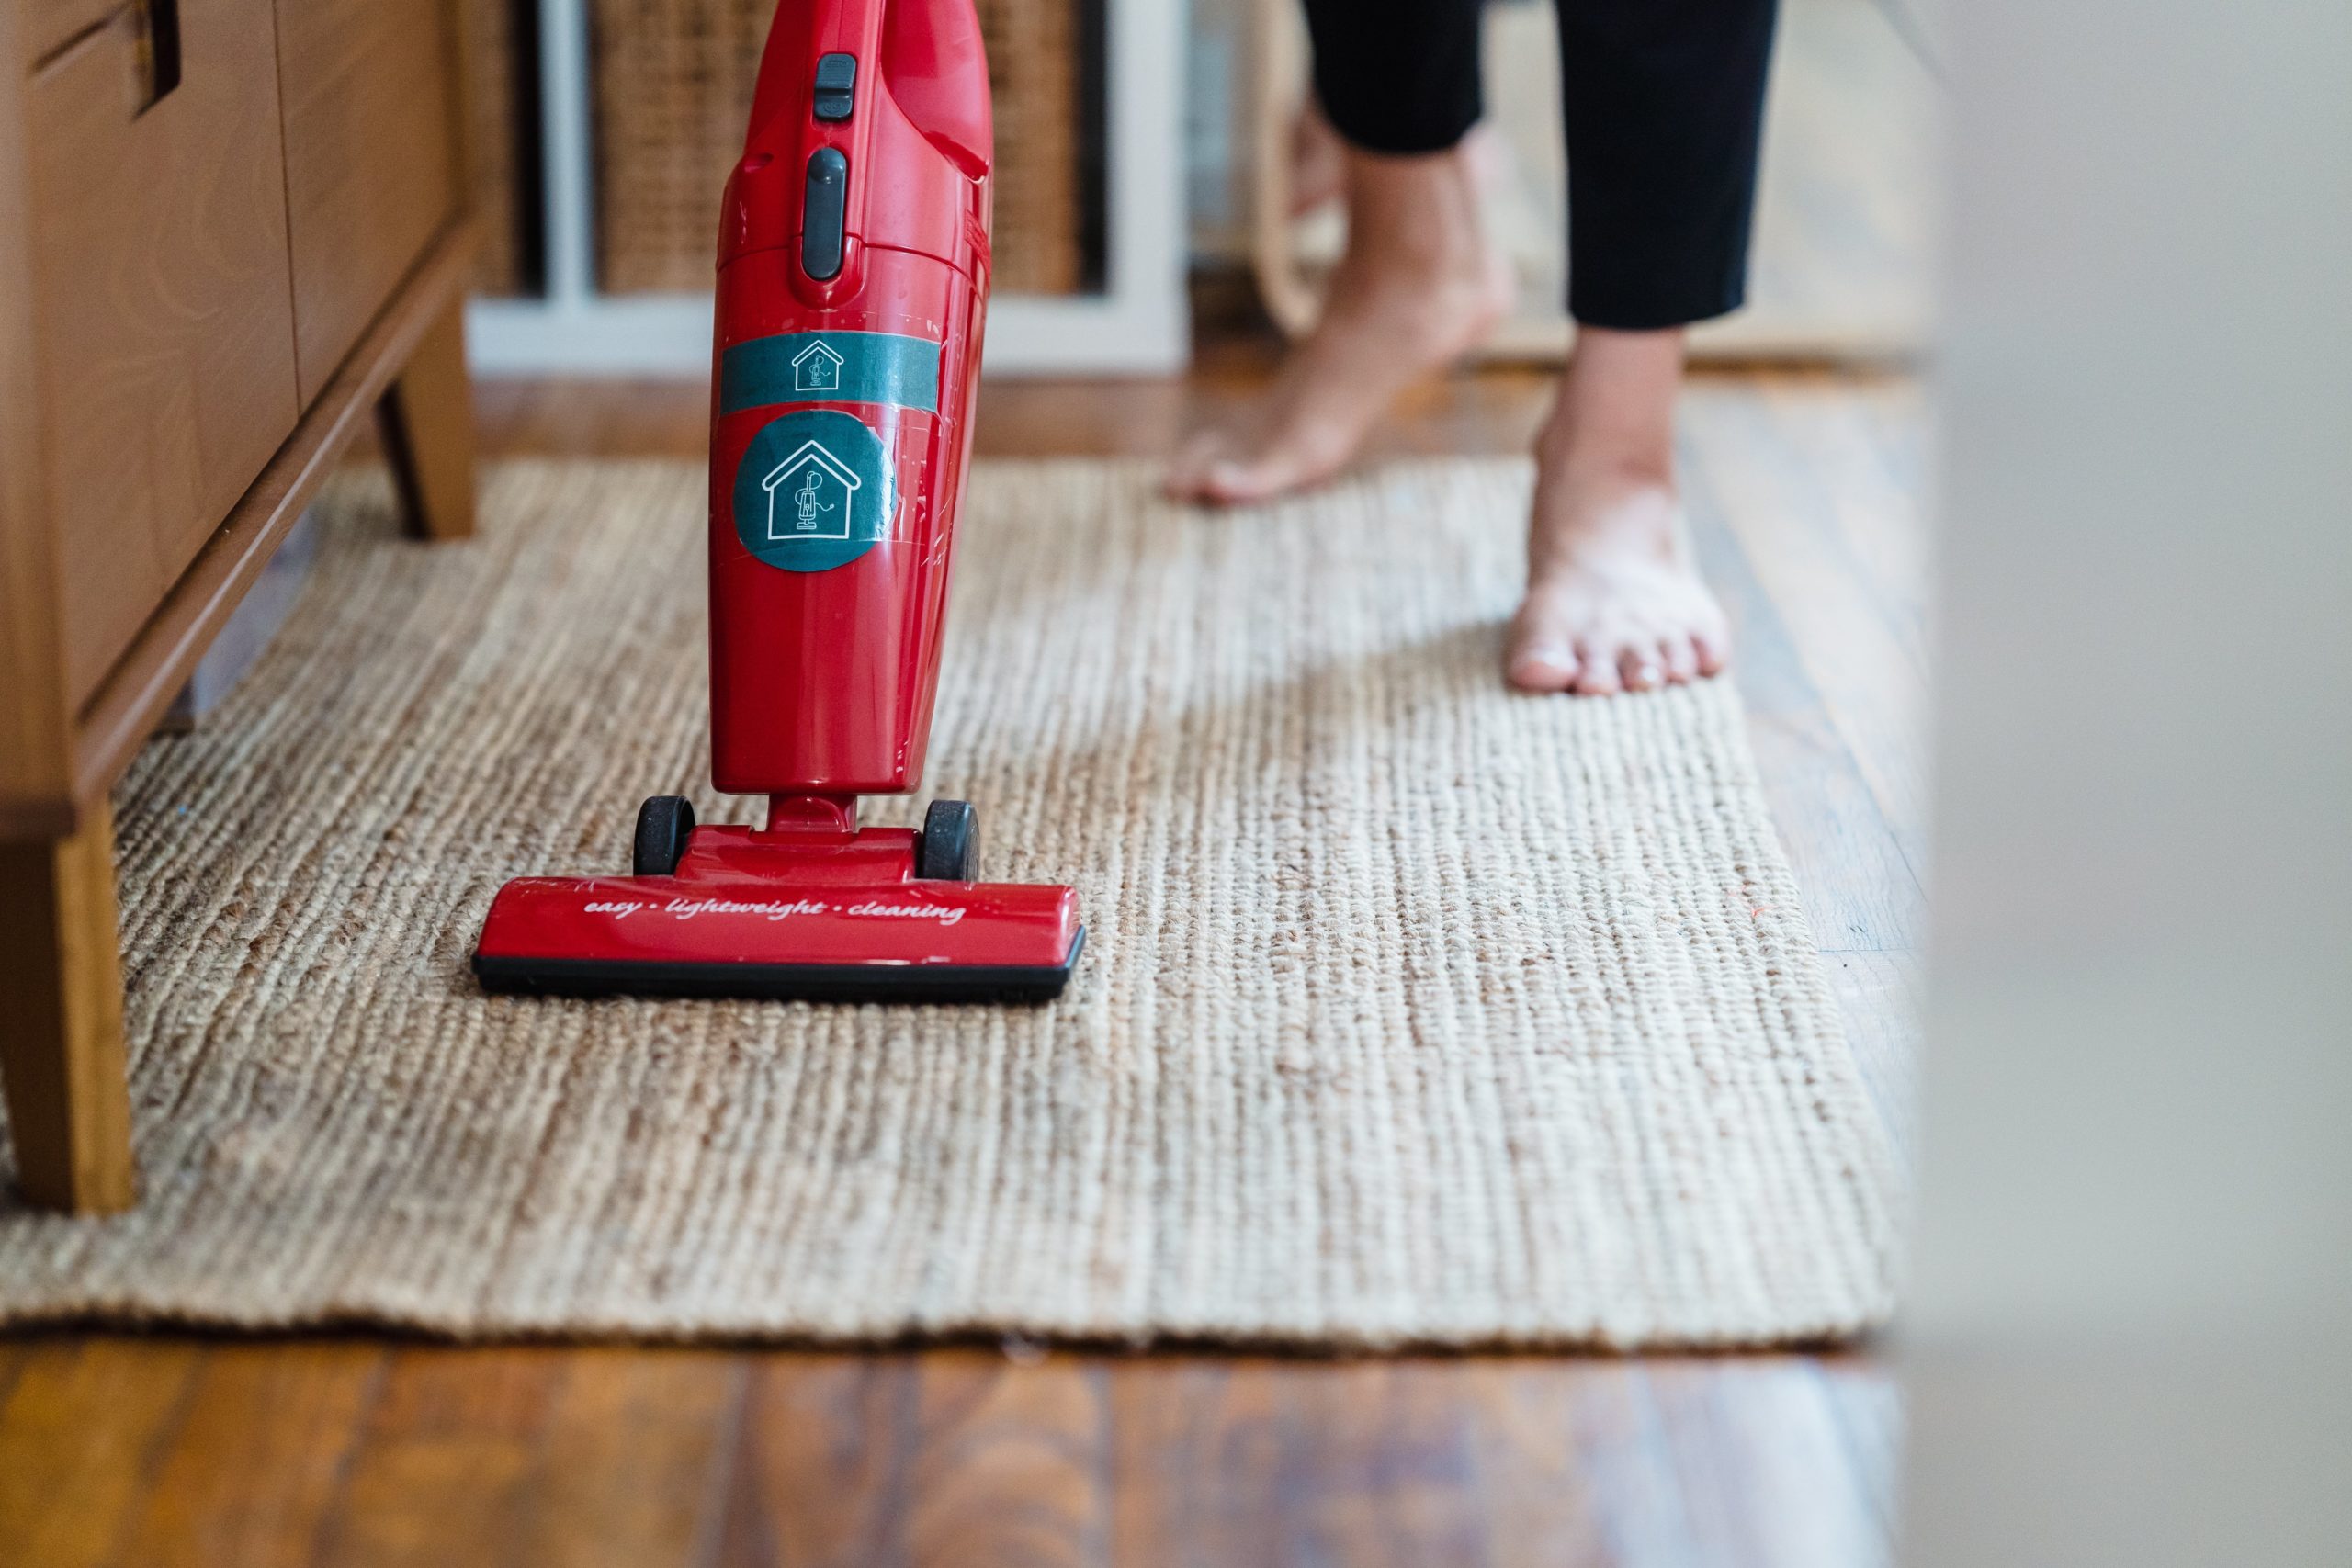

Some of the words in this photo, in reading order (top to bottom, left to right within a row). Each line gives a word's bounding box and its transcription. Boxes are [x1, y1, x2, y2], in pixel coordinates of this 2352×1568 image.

[583, 900, 643, 920] easy
[664, 898, 825, 921] lightweight
[847, 900, 967, 925] cleaning
